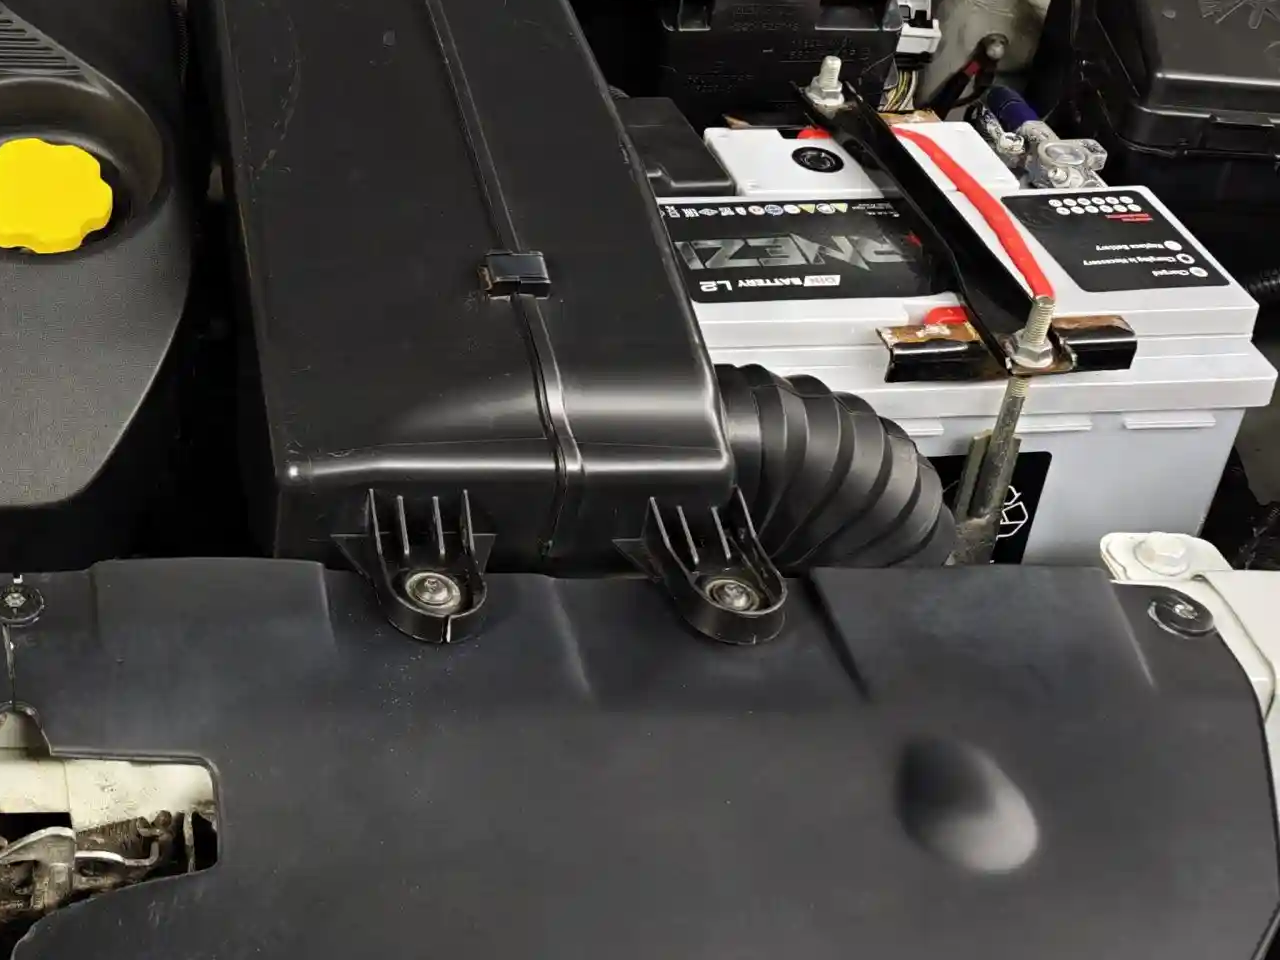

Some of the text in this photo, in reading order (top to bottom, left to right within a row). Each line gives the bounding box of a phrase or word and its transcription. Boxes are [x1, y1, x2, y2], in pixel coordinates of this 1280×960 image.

[673, 233, 914, 271] RNEZI
[699, 279, 732, 291] L2
[738, 277, 803, 288] BATTERY
